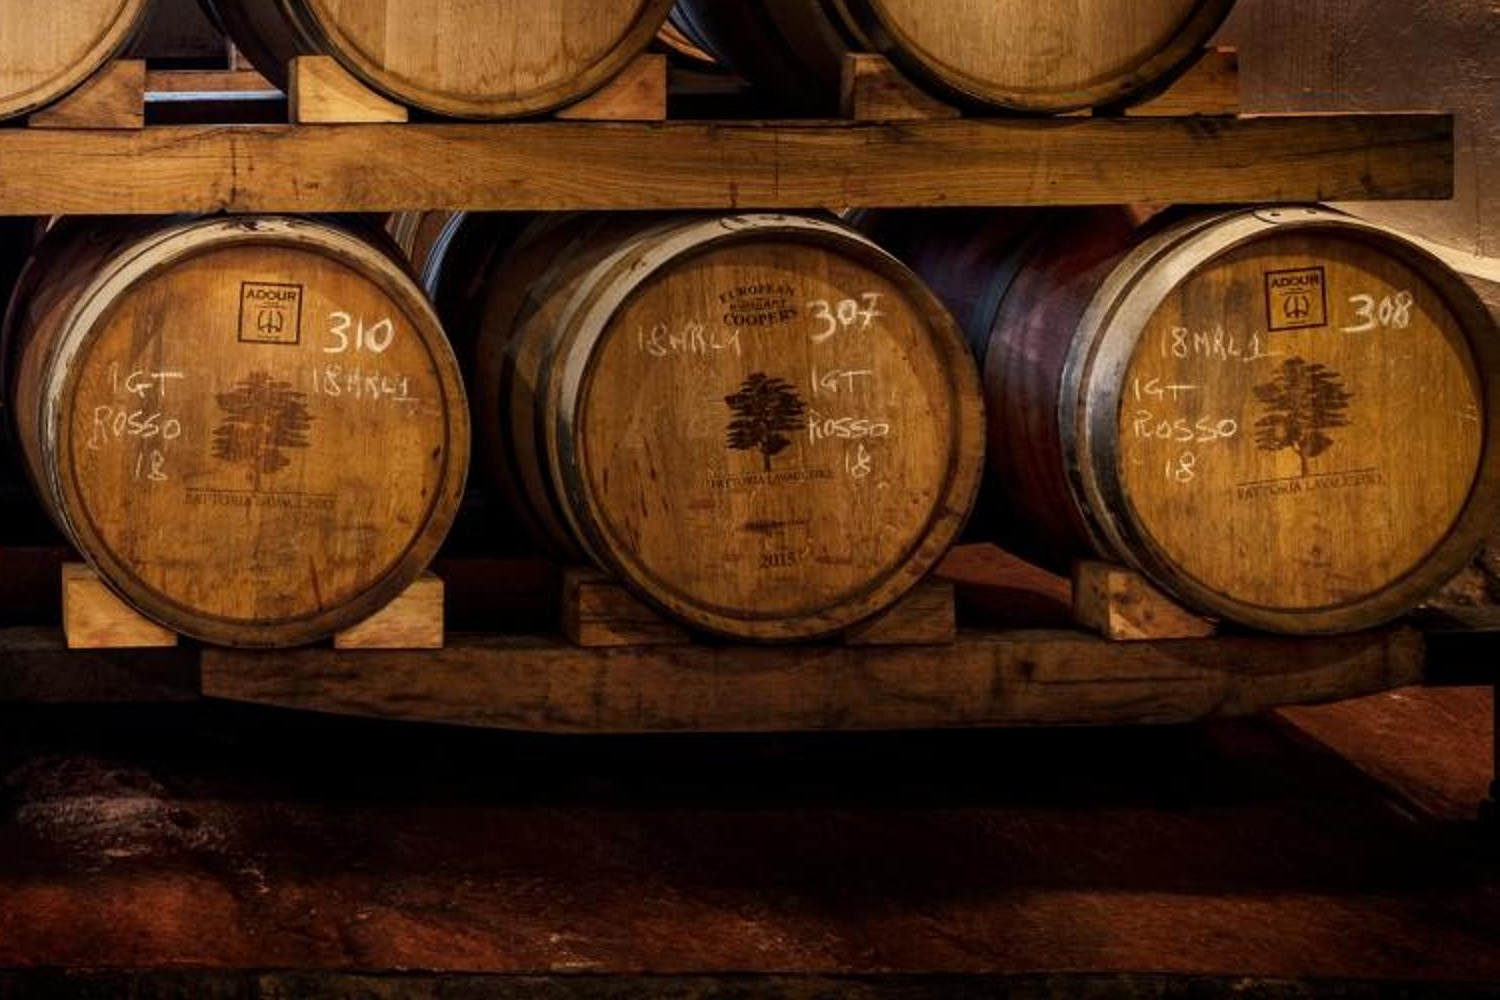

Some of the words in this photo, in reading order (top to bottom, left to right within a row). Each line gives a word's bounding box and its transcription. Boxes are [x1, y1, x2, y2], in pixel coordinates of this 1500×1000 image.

[245, 288, 298, 302] ADOUR
[719, 284, 795, 304] EUROPEAN
[723, 309, 798, 327] COOPERS
[807, 293, 885, 344] 307
[1340, 290, 1414, 333] 308
[323, 310, 395, 353] 310
